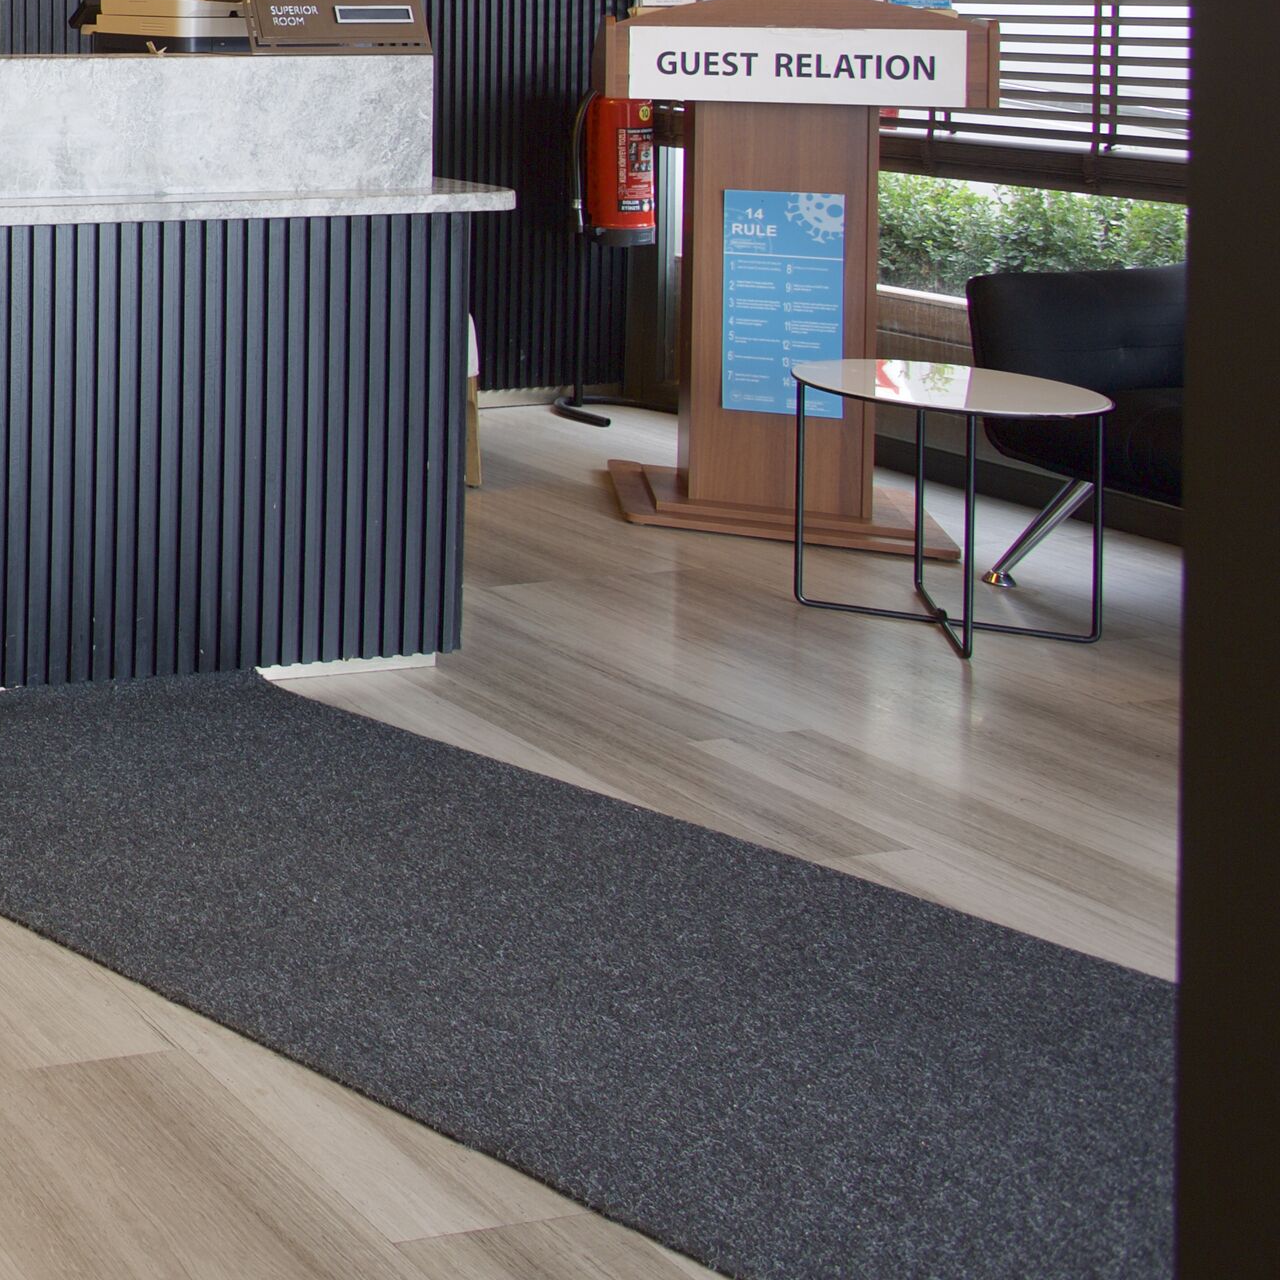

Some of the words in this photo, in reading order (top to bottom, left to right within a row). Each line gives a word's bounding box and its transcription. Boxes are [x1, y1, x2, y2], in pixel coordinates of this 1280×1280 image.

[270, 5, 319, 15] SUPERIOR
[272, 17, 305, 26] ROOM
[655, 50, 759, 78] GUEST
[774, 53, 936, 81] RELATION
[744, 207, 764, 220] 14
[731, 223, 777, 237] RULE
